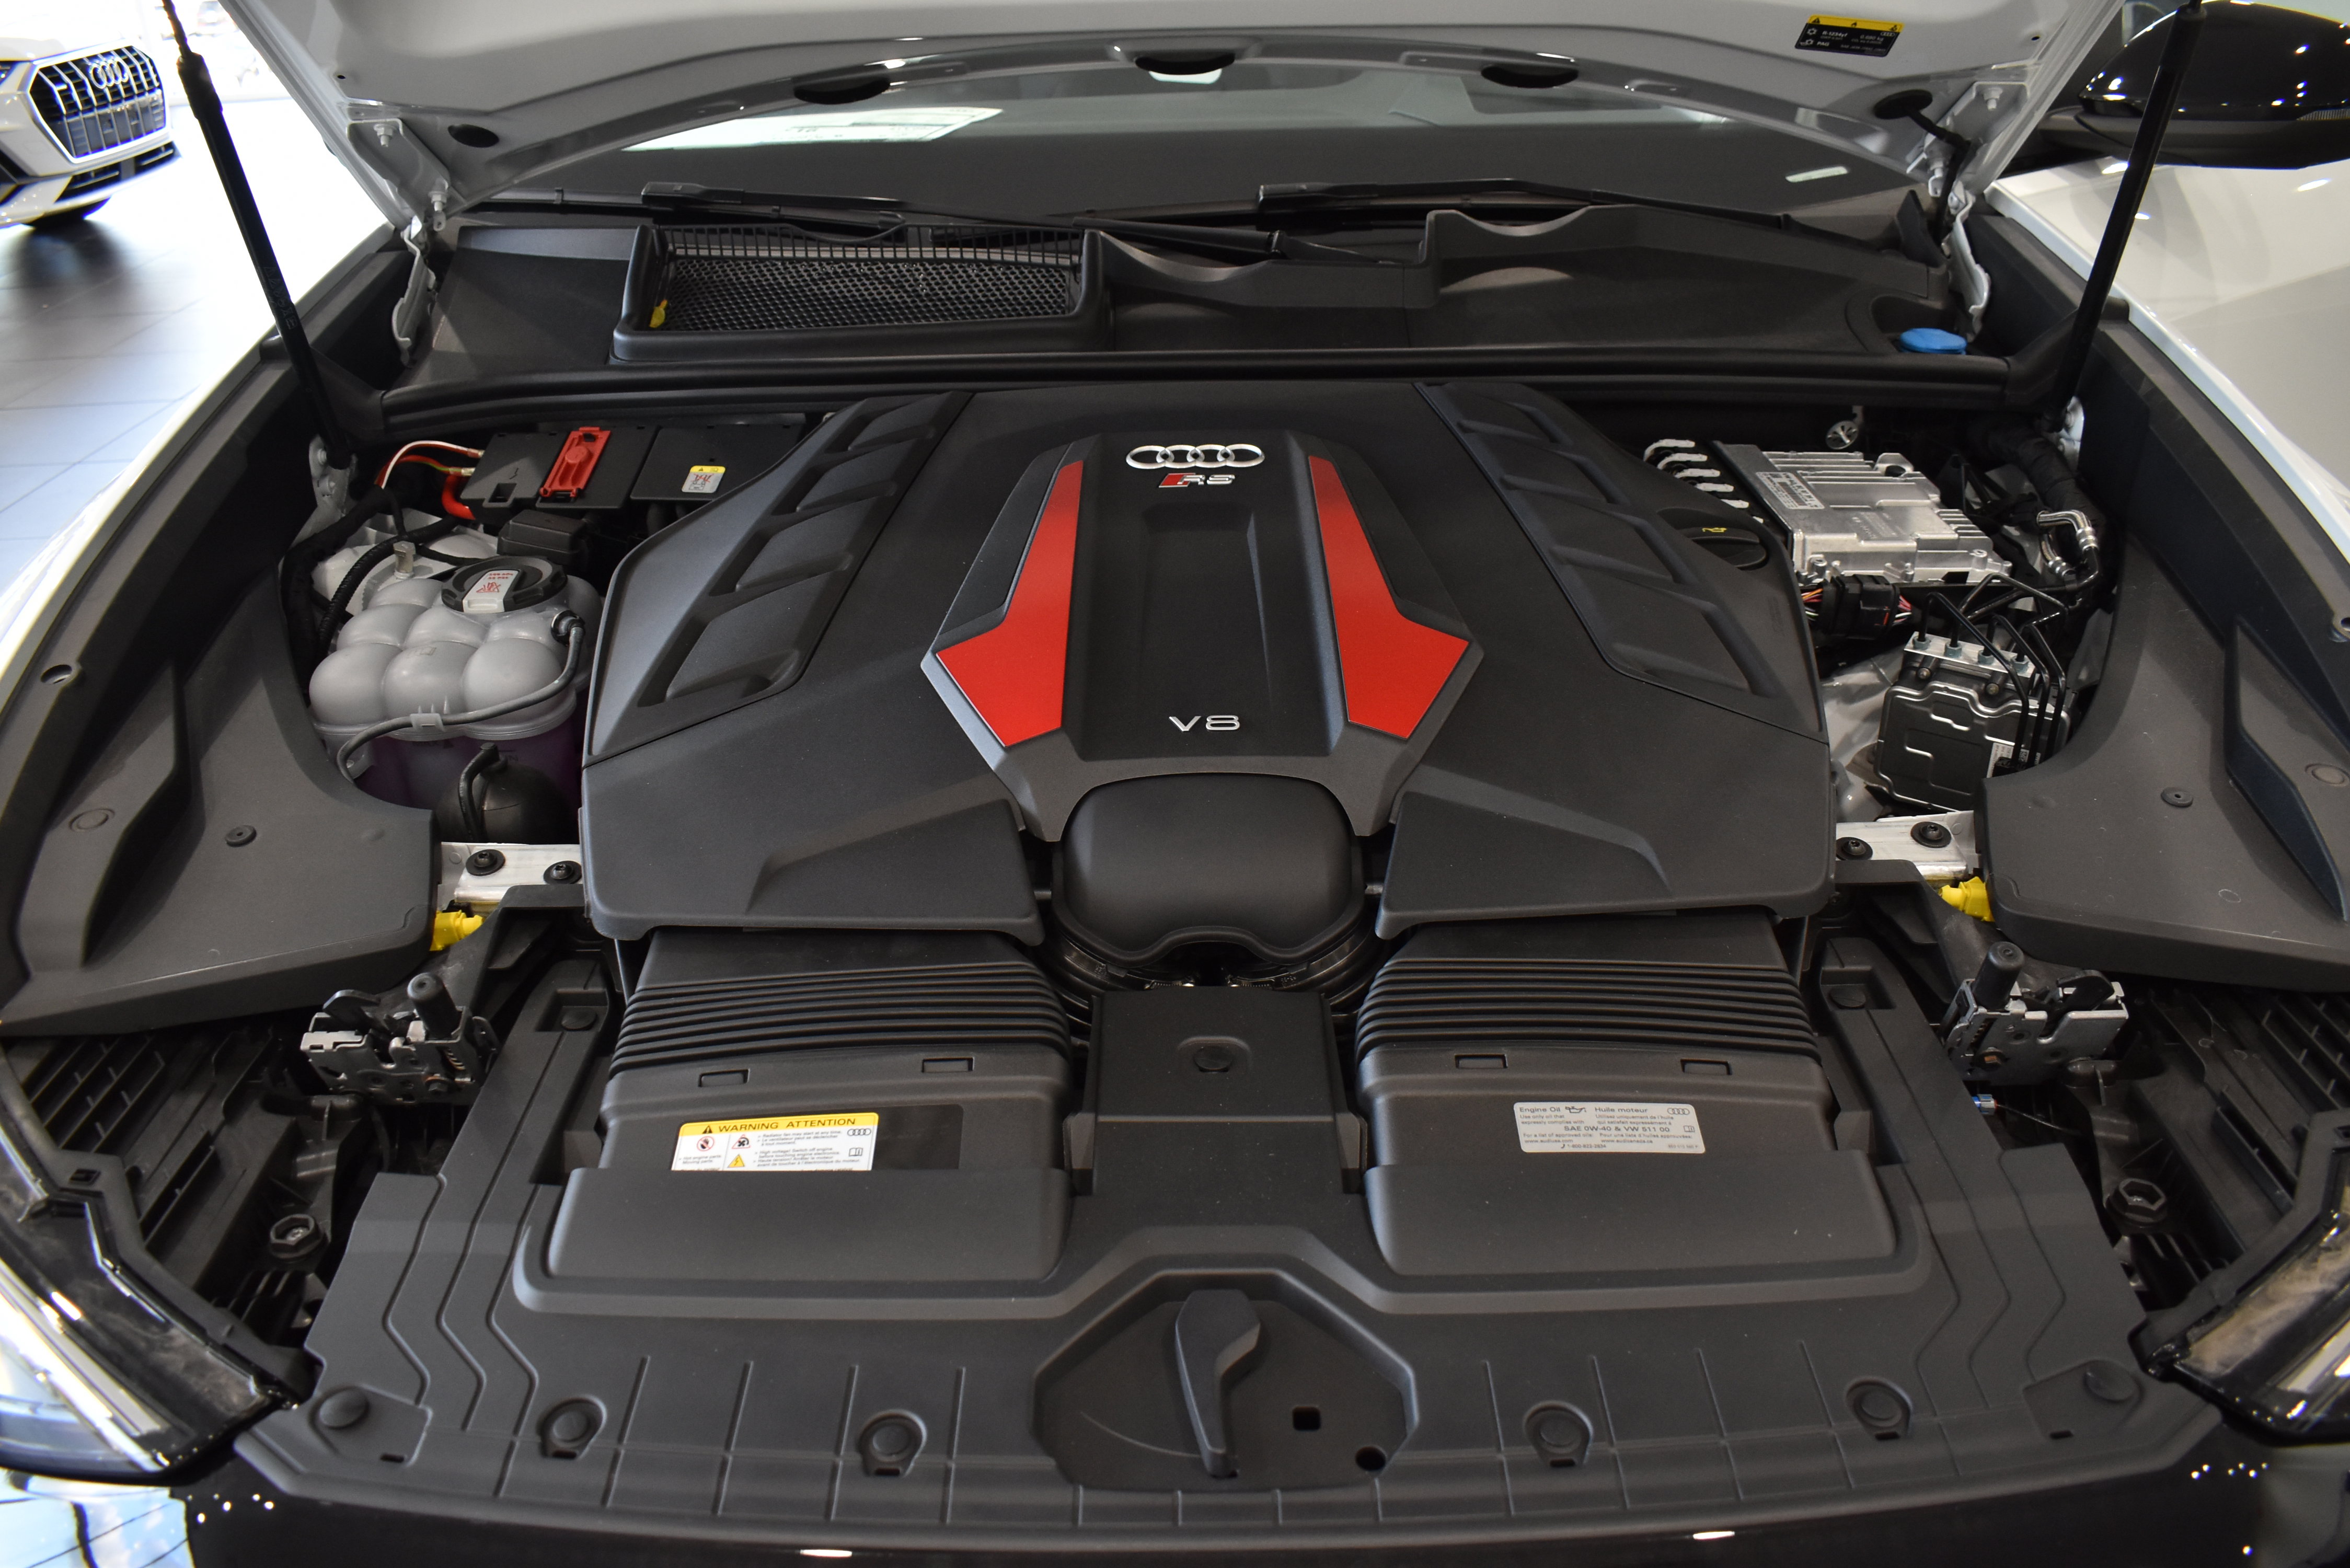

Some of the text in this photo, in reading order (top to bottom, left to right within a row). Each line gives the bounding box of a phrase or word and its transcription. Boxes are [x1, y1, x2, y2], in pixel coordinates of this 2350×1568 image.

[1177, 474, 1235, 486] RS
[1169, 715, 1240, 732] V8
[719, 1118, 856, 1133] WARNING ATTENTION
